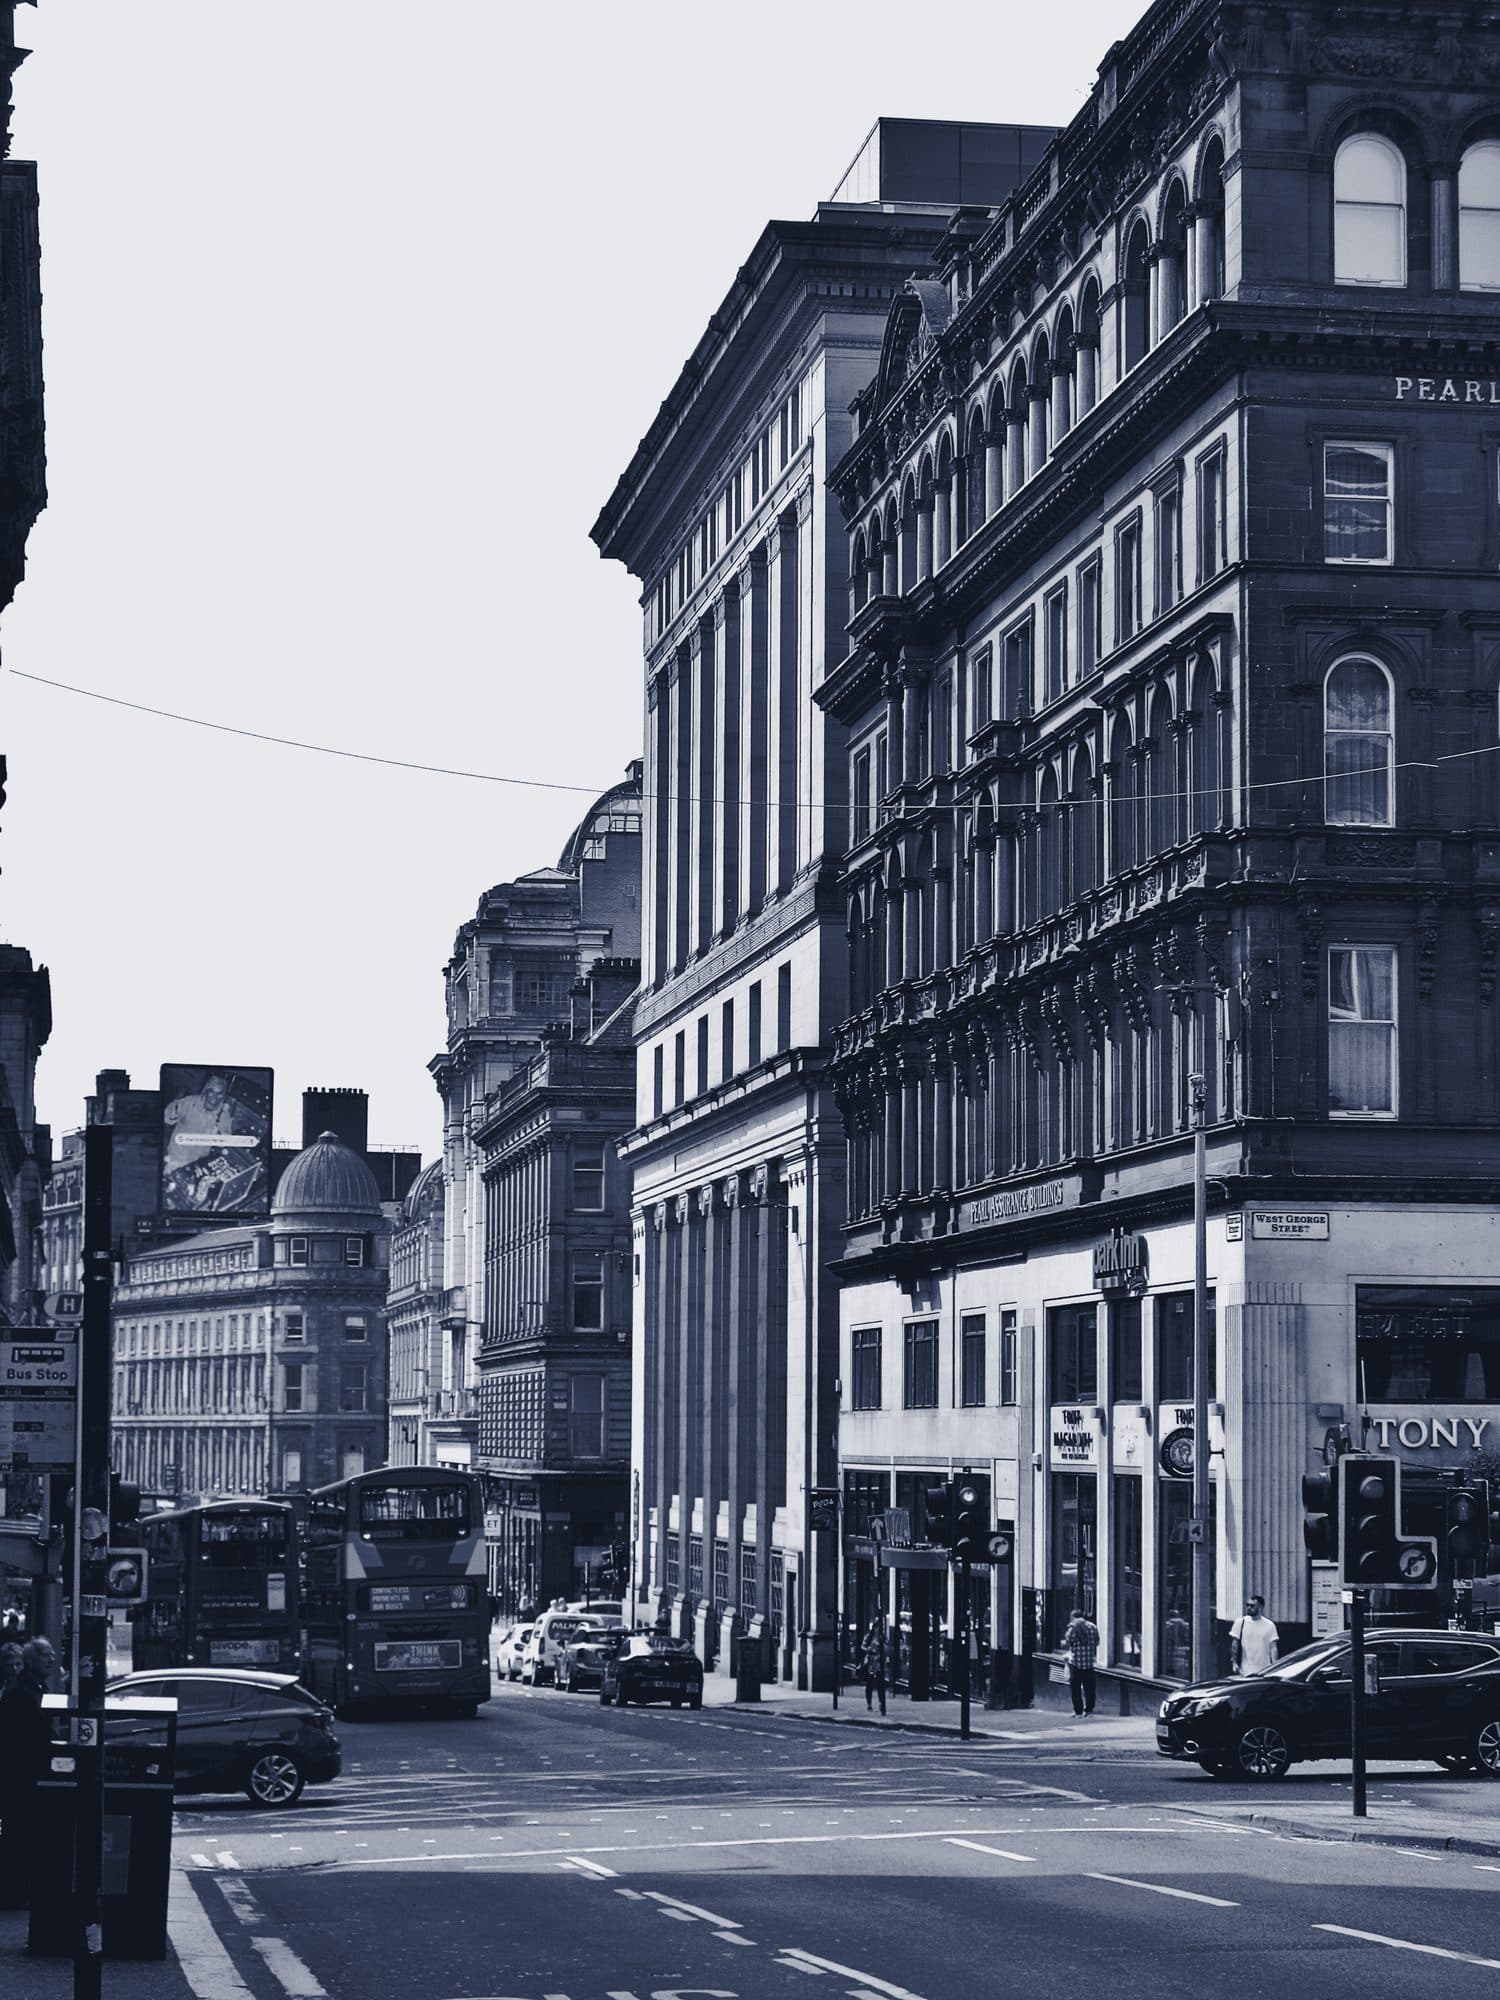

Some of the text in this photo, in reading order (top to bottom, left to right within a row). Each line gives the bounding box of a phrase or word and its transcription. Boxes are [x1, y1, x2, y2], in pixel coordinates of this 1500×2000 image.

[1394, 376, 1500, 403] PEARL
[970, 1181, 1064, 1225] PEARL ASSURANCE BUILDINGS
[1255, 1214, 1327, 1225] WEST GEORGE
[1271, 1223, 1311, 1233] STREET
[63, 1297, 76, 1313] H
[7, 1368, 67, 1382] Bus Stop
[1372, 1417, 1491, 1449] TONY
[487, 1519, 498, 1528] ET
